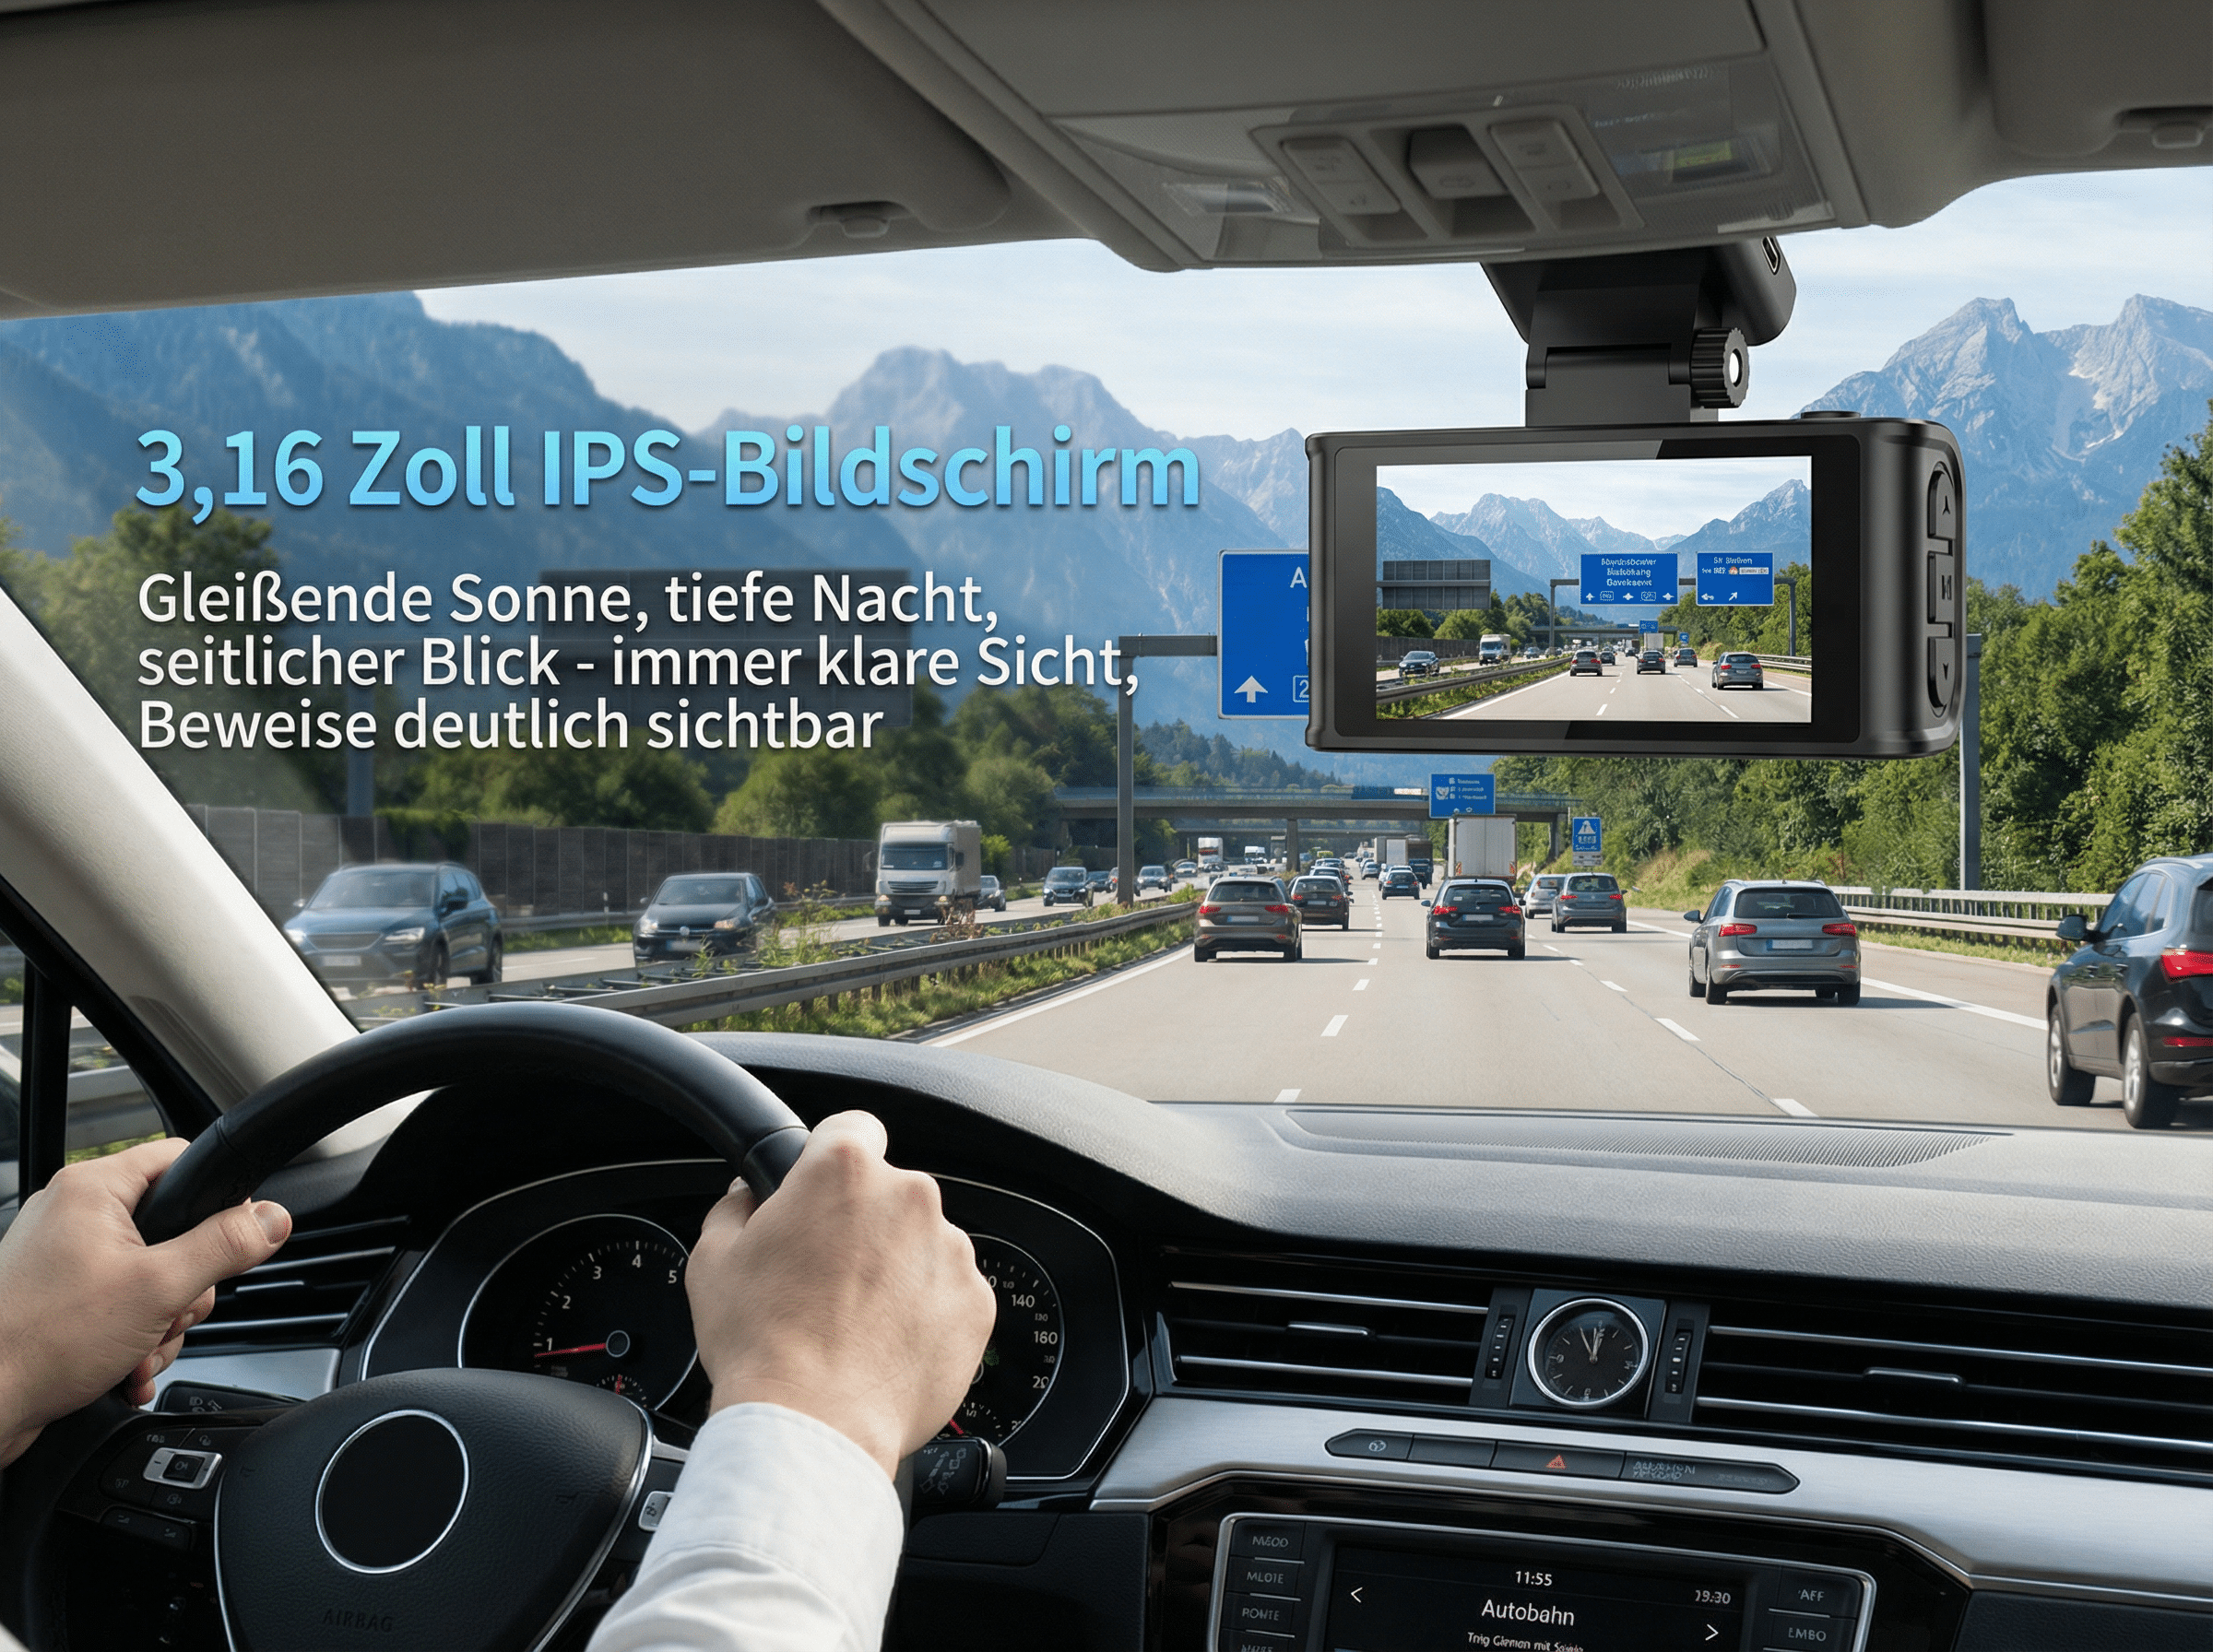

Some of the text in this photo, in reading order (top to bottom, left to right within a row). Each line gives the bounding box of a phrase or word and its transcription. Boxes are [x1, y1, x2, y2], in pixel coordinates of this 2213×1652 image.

[632, 1254, 643, 1268] 4
[592, 1266, 603, 1280] 3
[668, 1269, 679, 1284] 5
[562, 1295, 572, 1309] 2
[1012, 1294, 1035, 1308] 140
[546, 1337, 554, 1351] 1
[1034, 1330, 1059, 1345] 160
[1515, 1570, 1554, 1587] 11:55
[1481, 1599, 1575, 1627] Autobahn
[321, 1607, 395, 1634] AIRBAG
